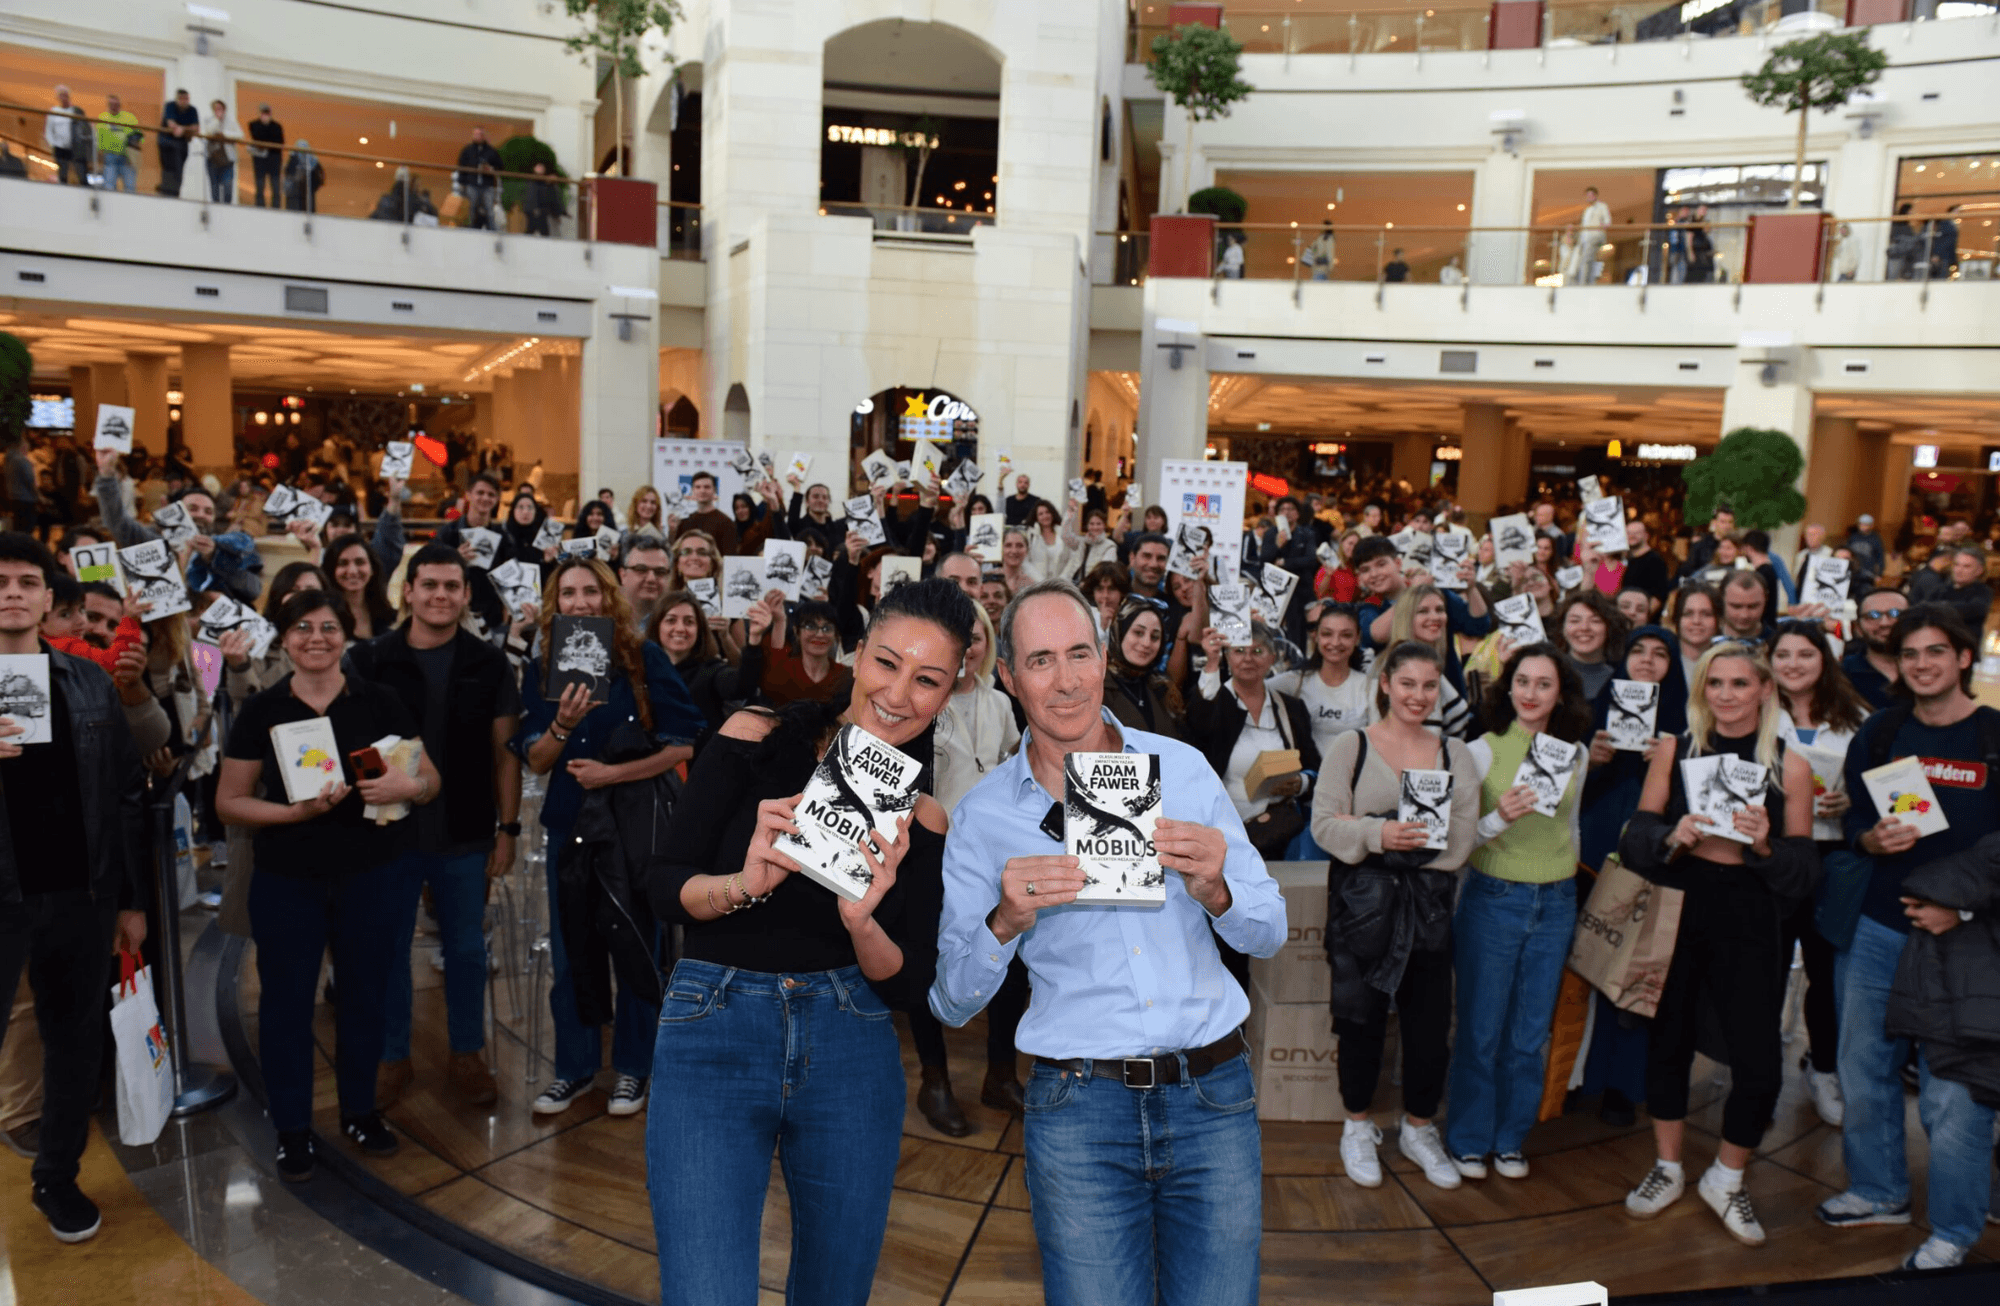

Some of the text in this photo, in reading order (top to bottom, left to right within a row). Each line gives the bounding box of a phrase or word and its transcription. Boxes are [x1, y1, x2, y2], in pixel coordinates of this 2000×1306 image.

[1319, 705, 1342, 720] Lee
[860, 746, 905, 777] ADAM
[852, 755, 901, 790] FAWER
[1091, 764, 1137, 777] ADAM
[1089, 777, 1140, 790] FAWER
[1419, 778, 1442, 786] ADAM
[1417, 785, 1442, 793] FAWER
